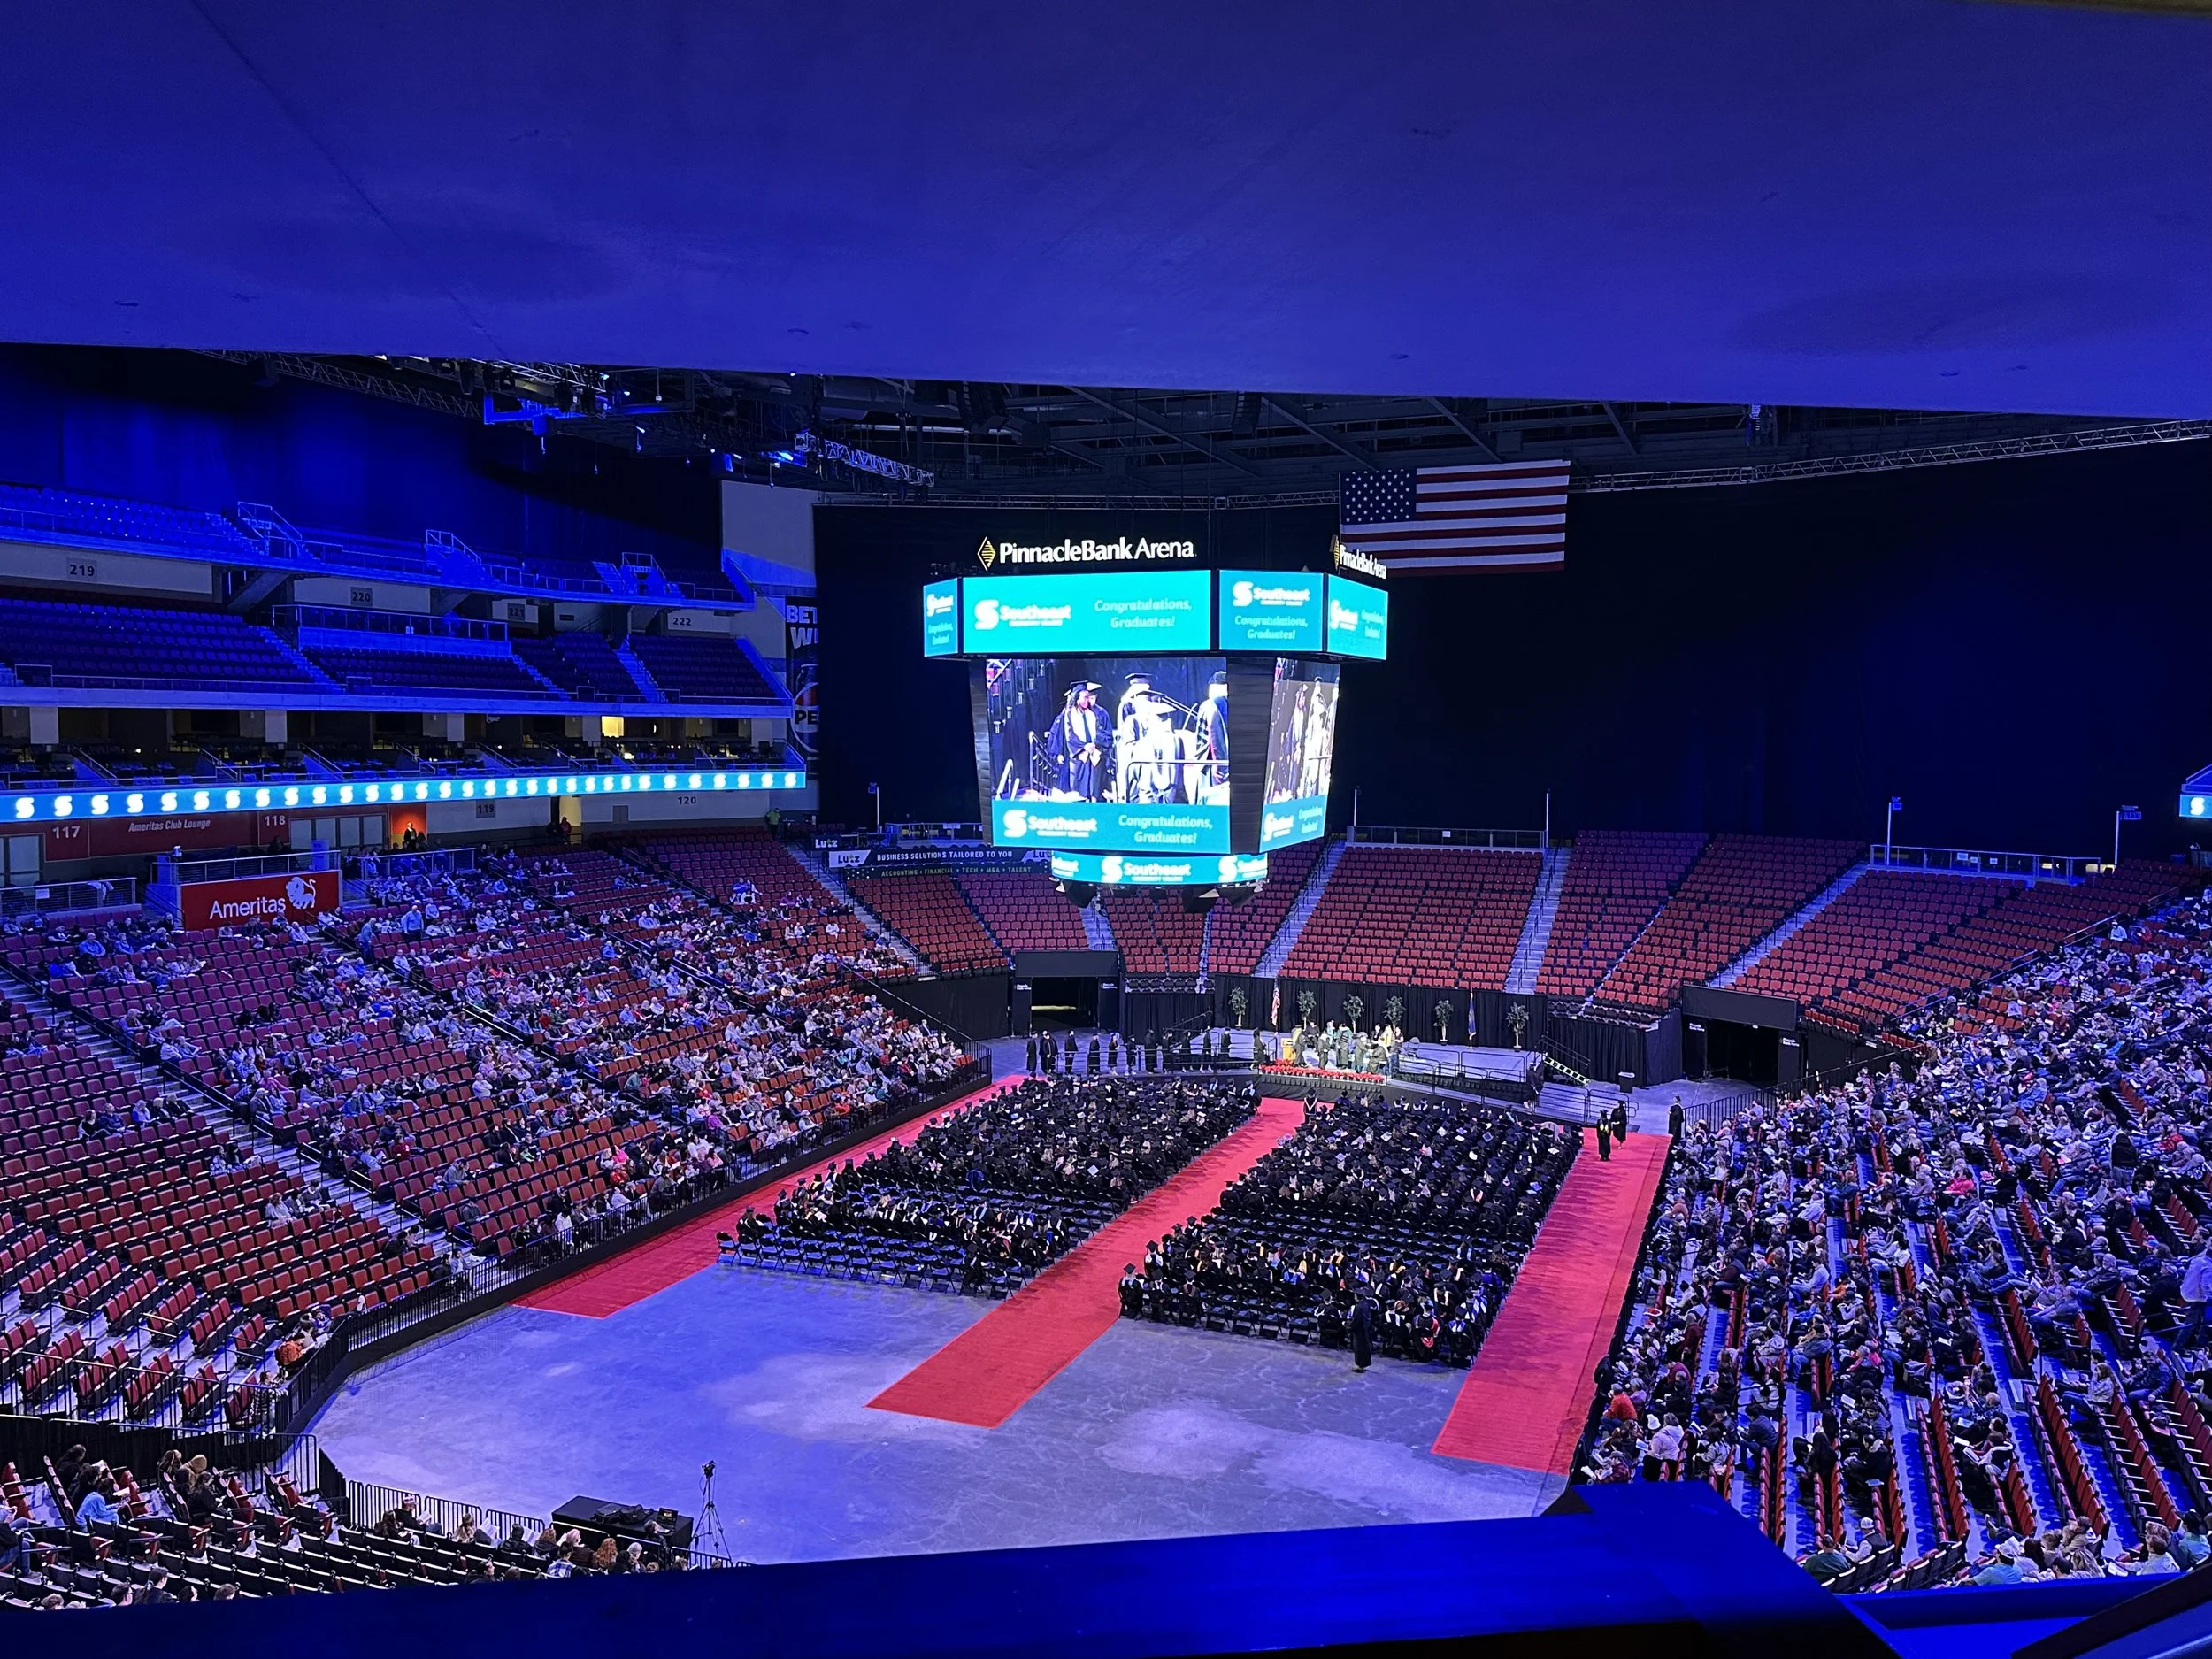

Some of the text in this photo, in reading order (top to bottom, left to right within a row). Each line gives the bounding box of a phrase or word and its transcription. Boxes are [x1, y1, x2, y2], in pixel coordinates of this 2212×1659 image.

[1134, 538, 1194, 559] Arena
[69, 564, 96, 577] 219
[352, 591, 372, 603] 220
[1094, 598, 1192, 613] Congratulations,
[1000, 604, 1071, 621] Southeast
[672, 618, 692, 626] 222
[1110, 617, 1175, 629] Graduates!
[1234, 615, 1309, 628] Congratulations,
[1247, 628, 1296, 640] Graduates!
[678, 796, 696, 805] 120
[478, 804, 495, 814] 119
[128, 818, 211, 833] Ameritas Club Lounge
[265, 816, 286, 826] 118
[1027, 815, 1097, 832] Southeast
[1118, 814, 1213, 830] Congratulations,
[52, 826, 81, 839] 117
[1134, 831, 1197, 844] Graduates!
[837, 855, 860, 864] Lutz
[877, 853, 909, 862] BUSINESS
[910, 851, 947, 861] SOLUTIONS
[1124, 862, 1191, 876] Southeast
[209, 896, 287, 919] Ameritas
